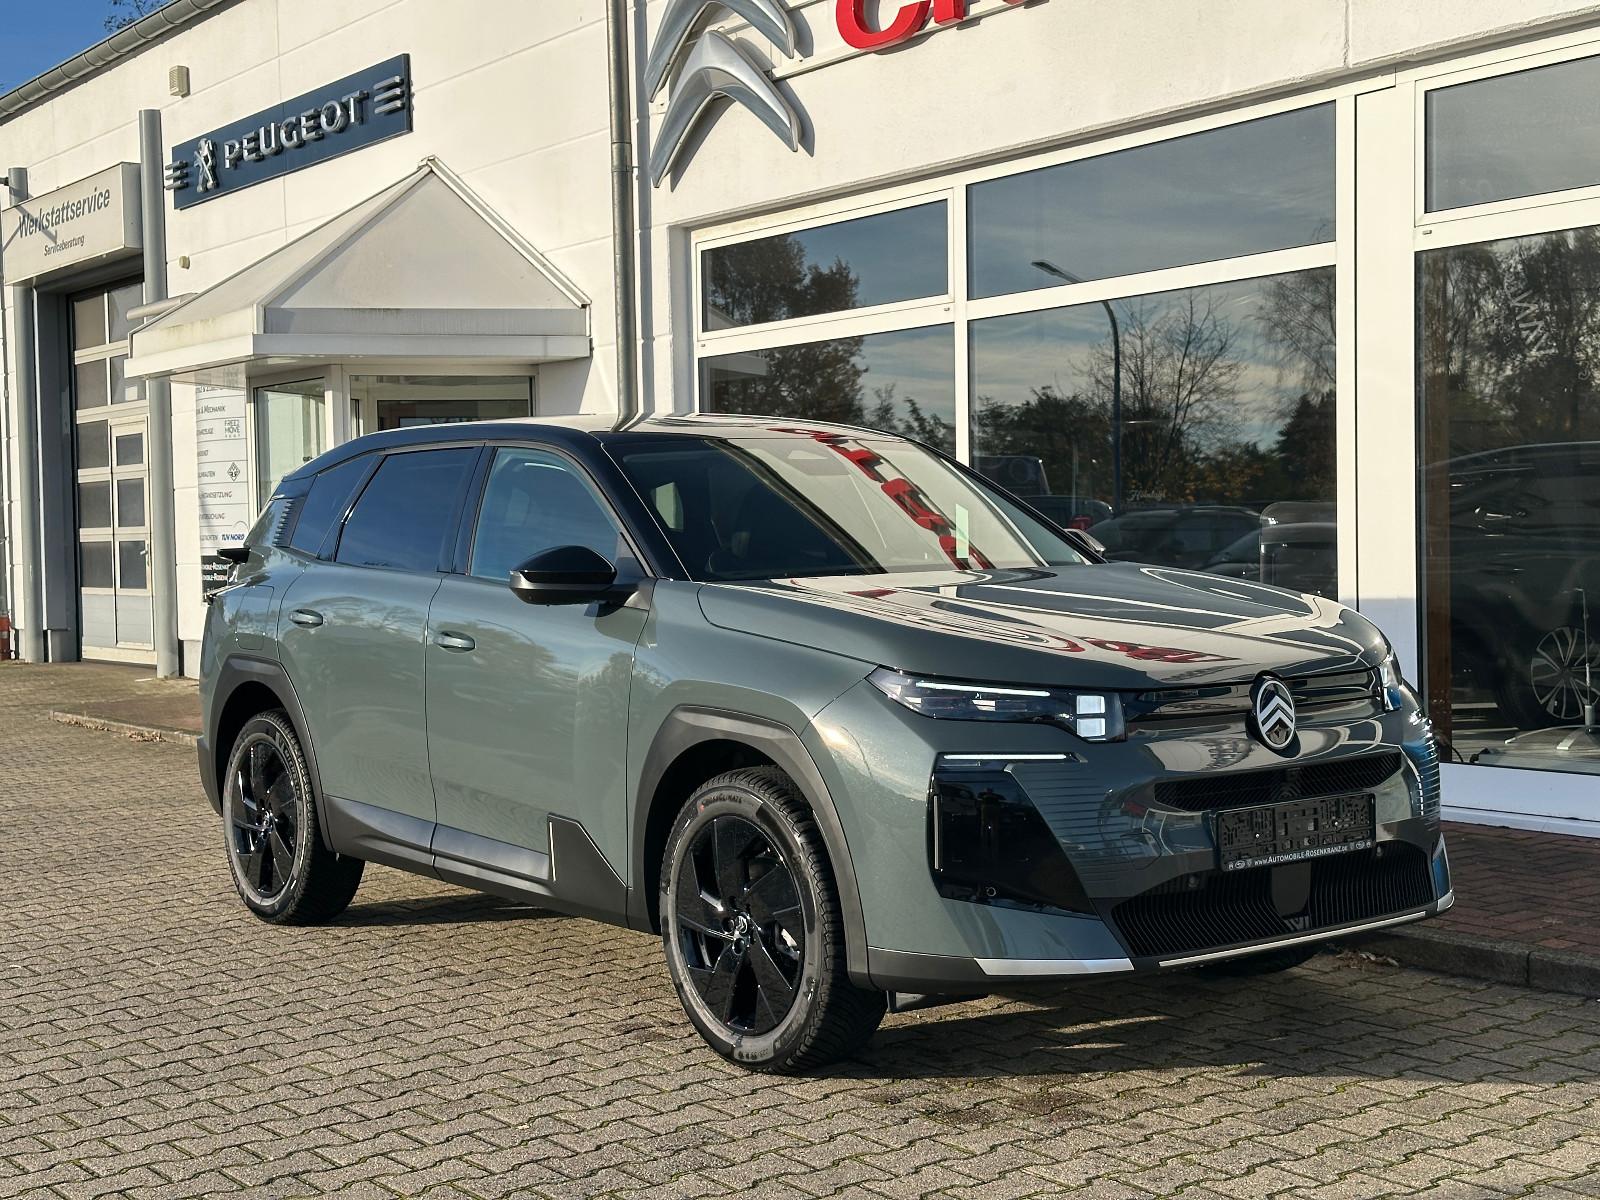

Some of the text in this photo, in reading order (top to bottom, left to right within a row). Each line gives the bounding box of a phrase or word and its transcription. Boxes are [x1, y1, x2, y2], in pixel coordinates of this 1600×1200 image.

[224, 89, 369, 169] PEUGEOT
[18, 185, 111, 238] Werkstattservice
[43, 235, 86, 256] Serviceberatung
